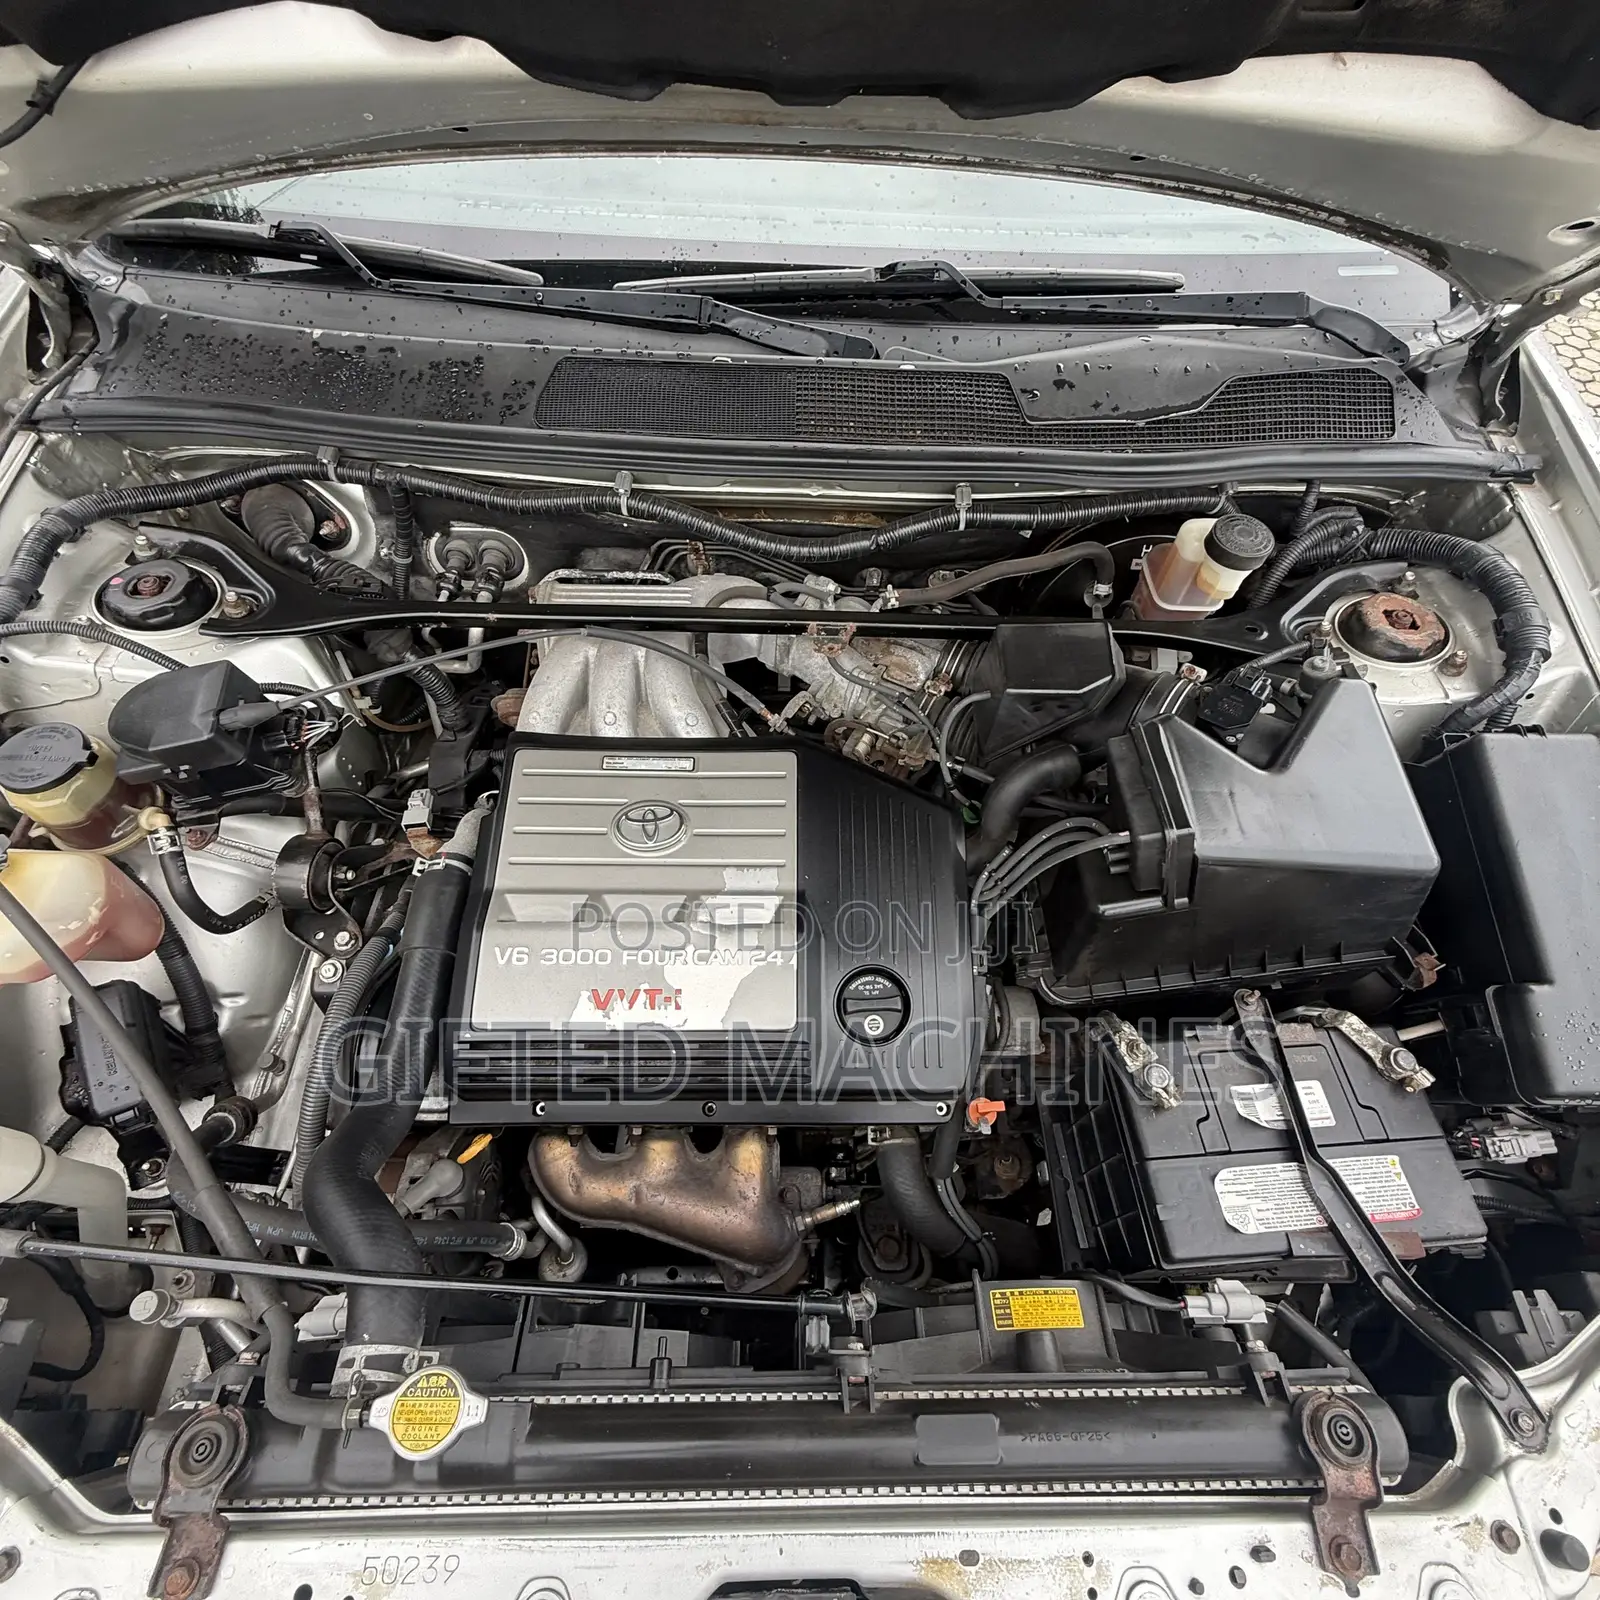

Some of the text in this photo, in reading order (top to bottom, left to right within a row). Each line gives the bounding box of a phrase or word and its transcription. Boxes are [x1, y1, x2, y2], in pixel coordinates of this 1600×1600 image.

[494, 946, 529, 966] V6
[540, 947, 611, 966] 3000
[622, 949, 688, 966] FOUR
[694, 948, 742, 966] CAM
[591, 988, 682, 1011] VVT-i
[406, 1387, 455, 1397] CAUTION
[466, 1405, 479, 1417] 1.1
[404, 1425, 439, 1433] ENGINE
[360, 1553, 461, 1587] 50239
